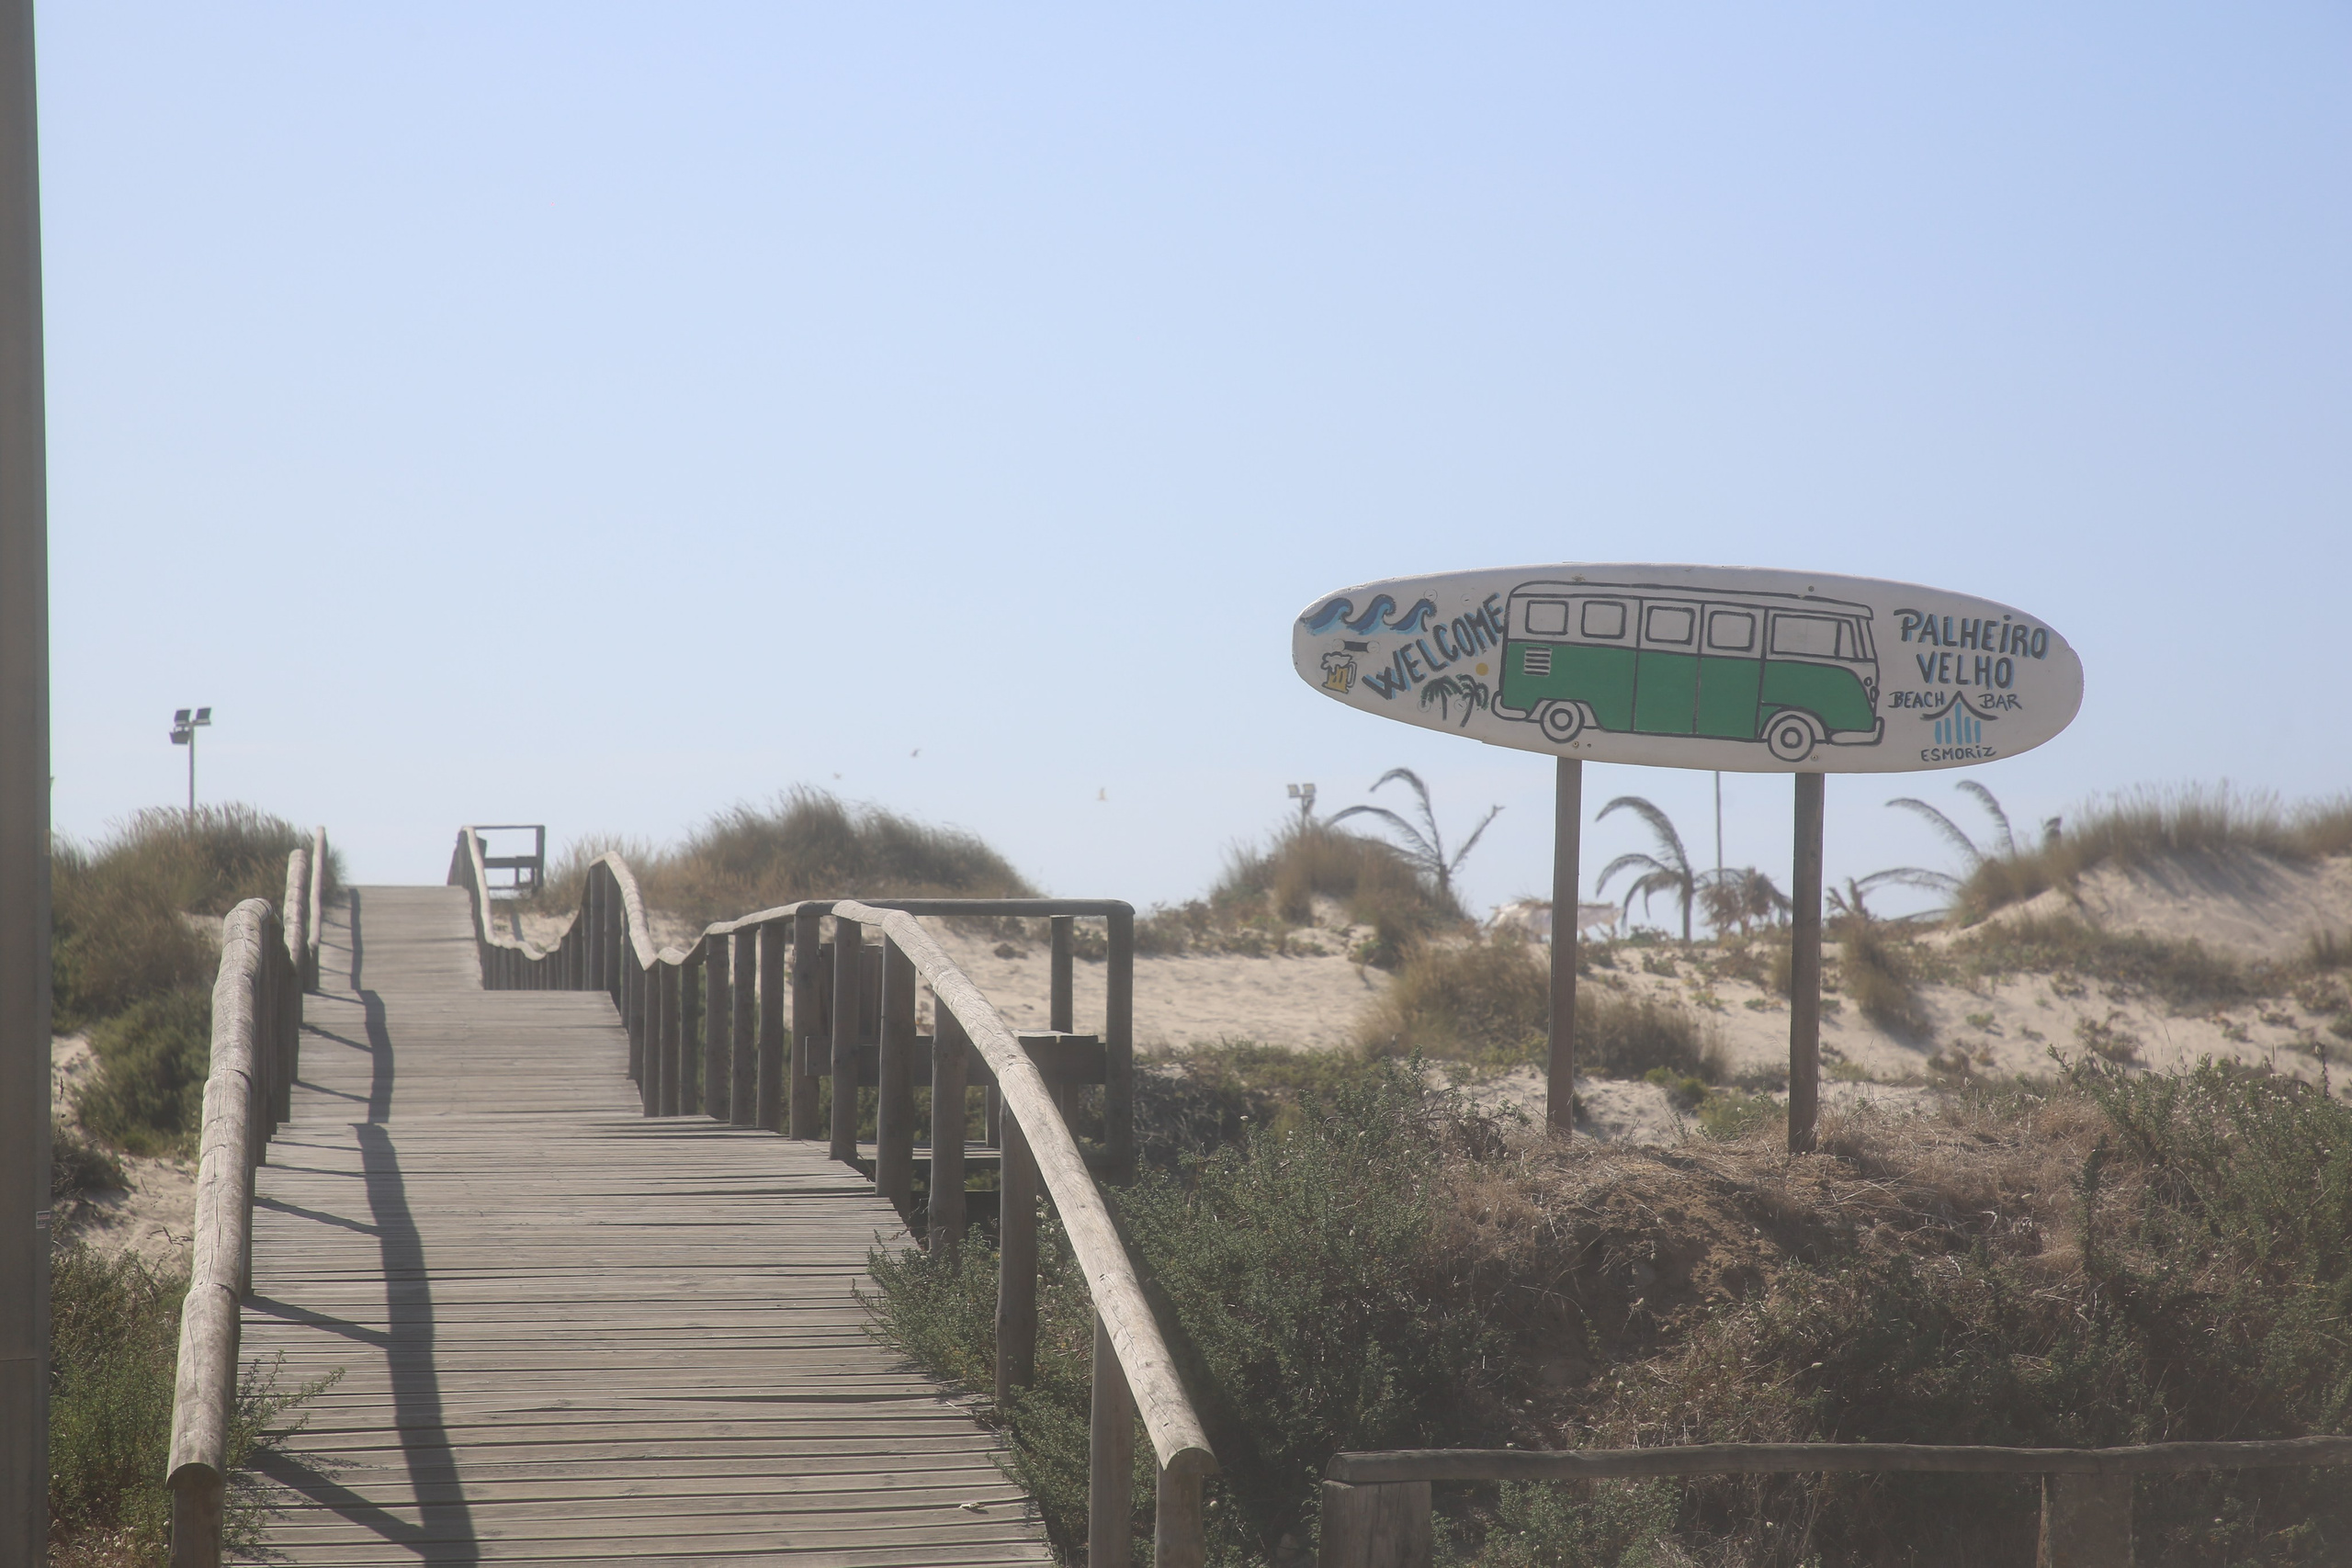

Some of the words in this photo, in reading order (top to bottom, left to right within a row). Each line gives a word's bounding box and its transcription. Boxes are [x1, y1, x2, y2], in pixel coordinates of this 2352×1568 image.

[1362, 592, 1505, 700] WELCOME
[1916, 650, 2015, 690] VELHO
[1888, 691, 1947, 708] BEACH
[1978, 694, 2023, 711] BAR
